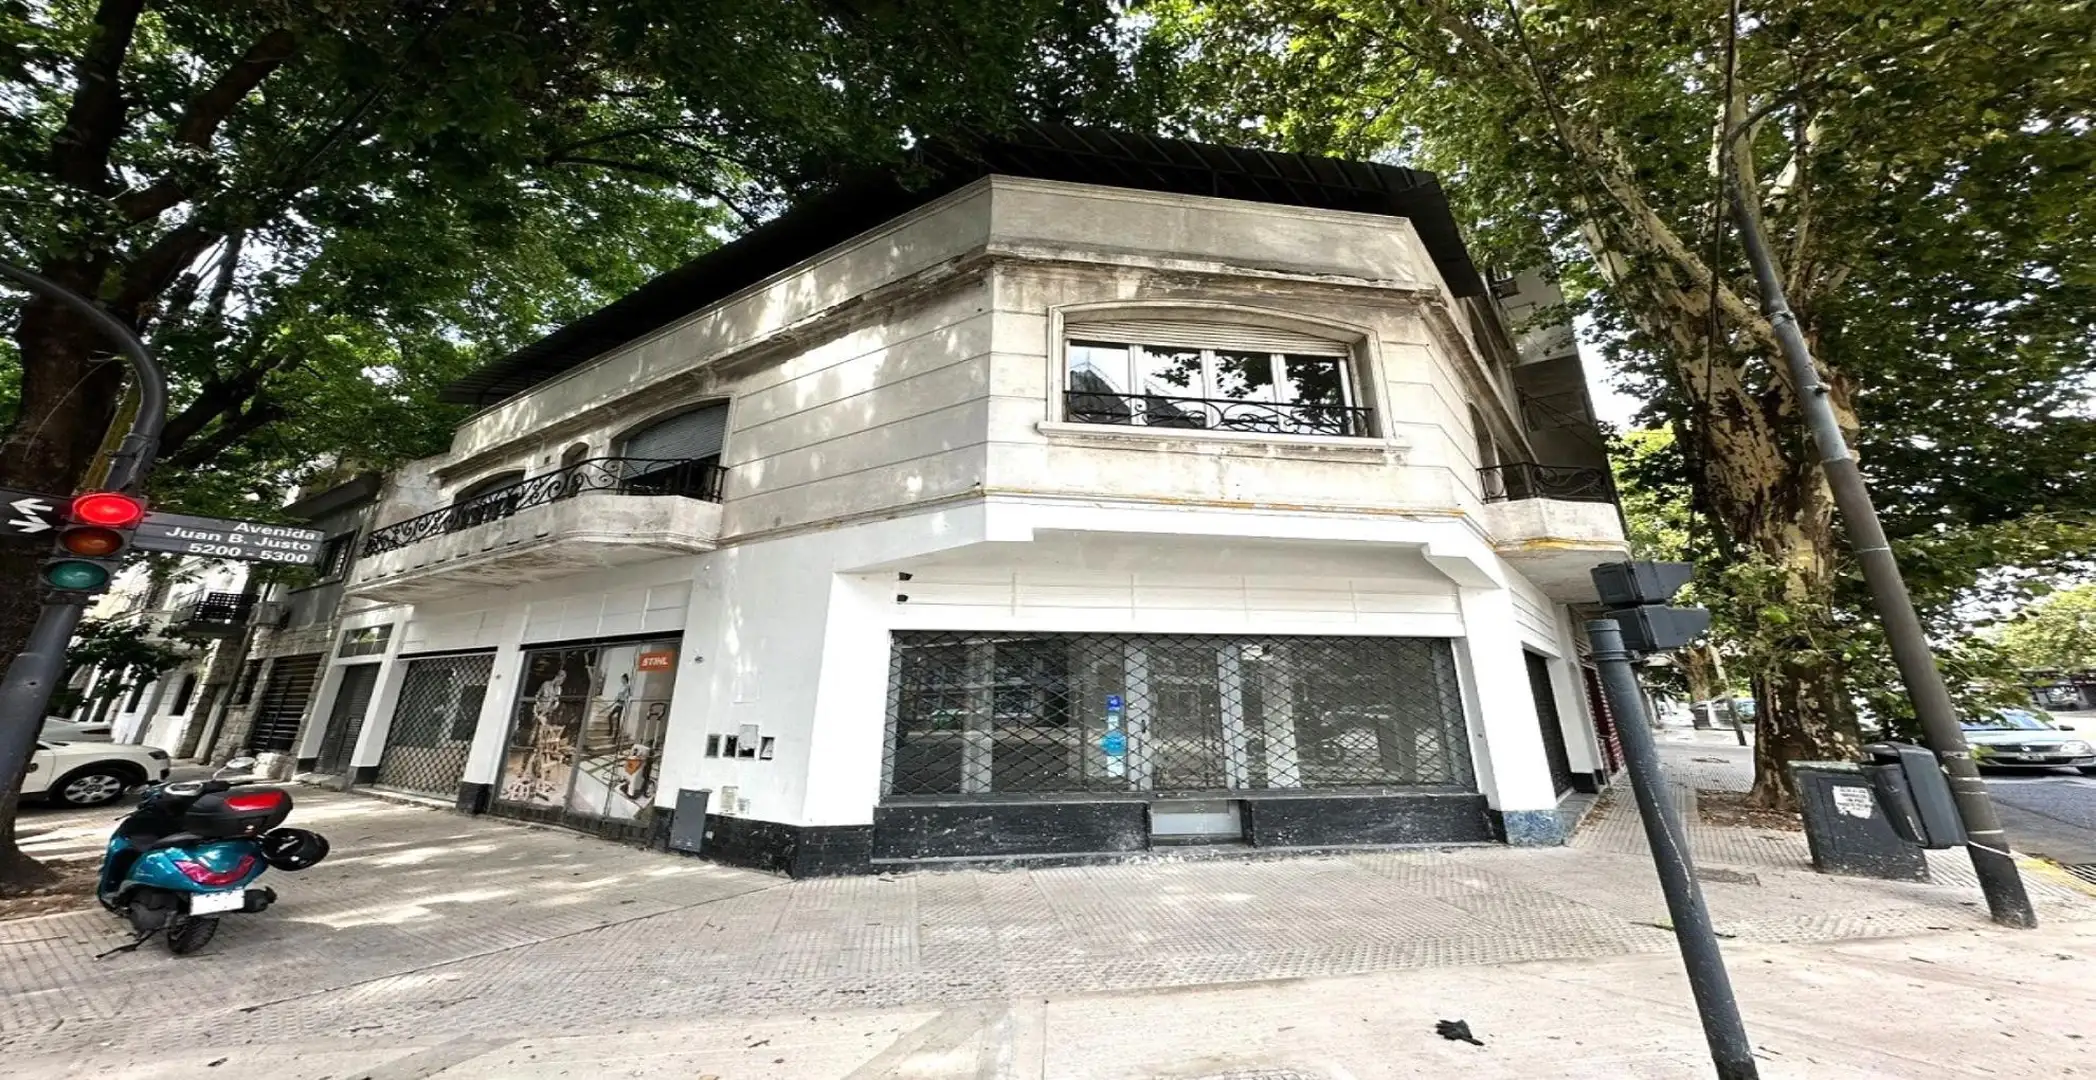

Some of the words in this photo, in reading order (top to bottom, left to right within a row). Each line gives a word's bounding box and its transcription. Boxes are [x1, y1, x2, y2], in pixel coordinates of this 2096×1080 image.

[165, 527, 222, 541] Juan
[228, 533, 249, 544] B.
[254, 537, 312, 551] Justo
[233, 522, 315, 540] Avenida
[188, 543, 242, 557] 5200
[259, 550, 308, 563] 5300
[641, 656, 668, 667] STIHL
